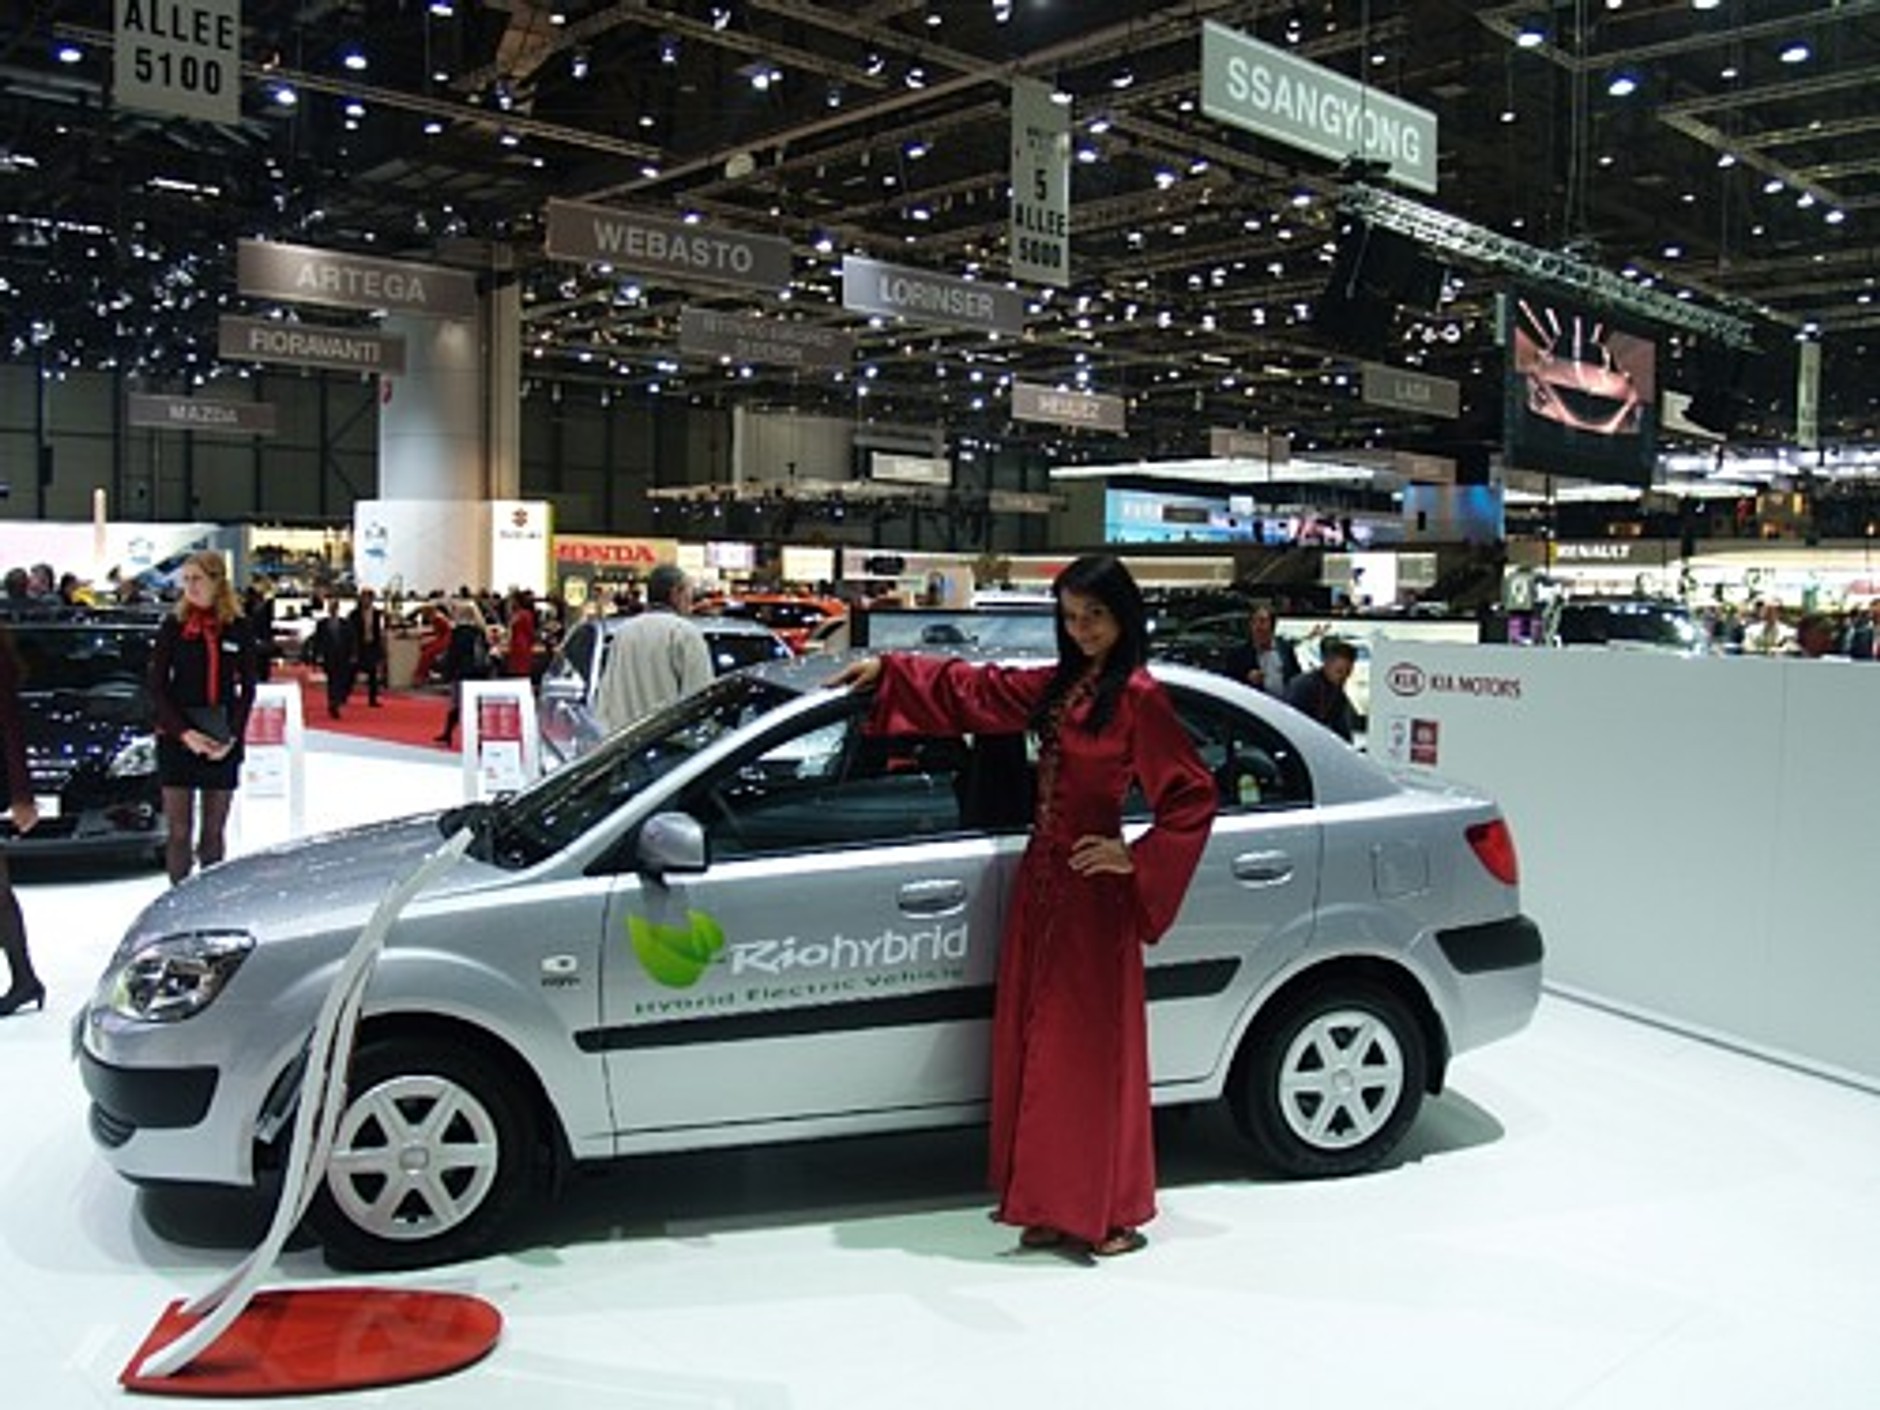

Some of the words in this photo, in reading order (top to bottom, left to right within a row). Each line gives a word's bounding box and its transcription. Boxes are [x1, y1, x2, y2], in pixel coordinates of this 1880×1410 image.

[122, 0, 235, 51] ALLEE
[134, 49, 221, 96] 5100
[1226, 56, 1421, 164] SSANGYONG
[1034, 168, 1048, 201] 5
[1014, 203, 1066, 238] ALLEE
[594, 219, 754, 273] WEBASTO
[297, 263, 427, 303] ARTEGA
[879, 275, 994, 320] LORINSER
[248, 328, 381, 363] FIORAVANTI
[168, 403, 238, 424] MAZDA
[1556, 544, 1630, 560] RENAULT
[1459, 674, 1521, 698] MOTORS
[748, 980, 855, 1000] Electric
[864, 967, 966, 987] Vehicle
